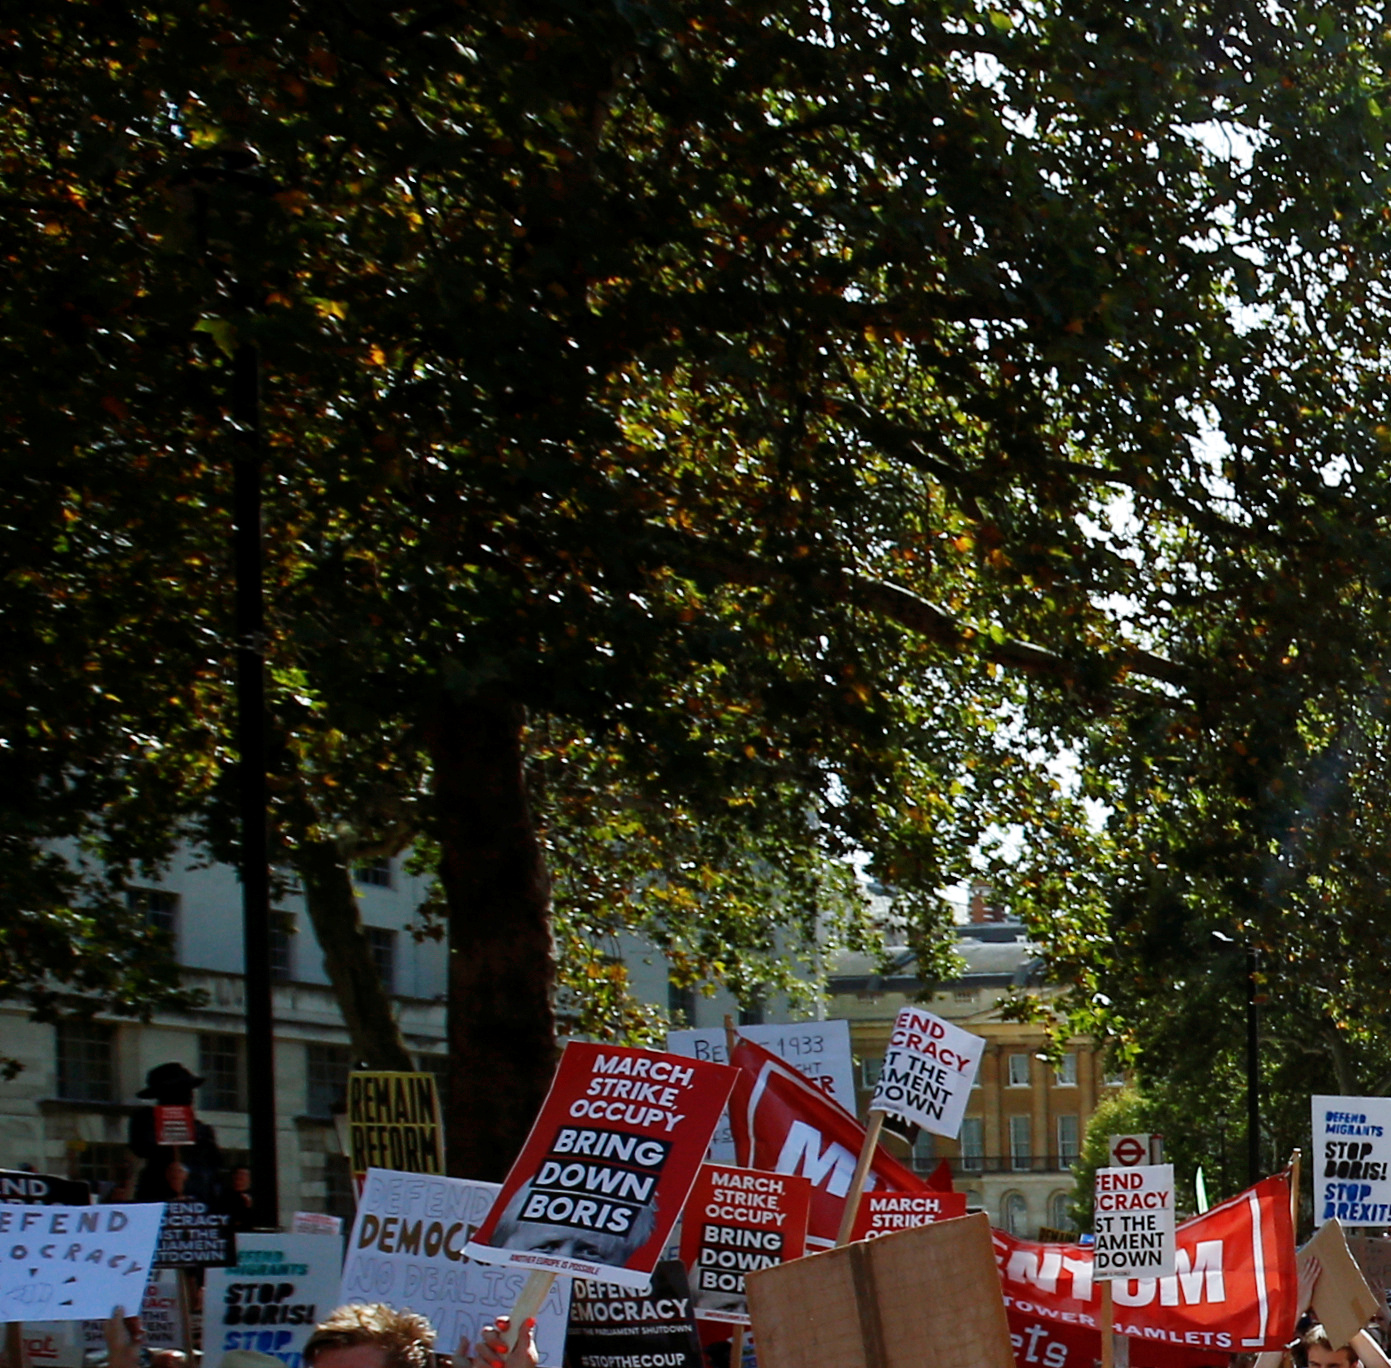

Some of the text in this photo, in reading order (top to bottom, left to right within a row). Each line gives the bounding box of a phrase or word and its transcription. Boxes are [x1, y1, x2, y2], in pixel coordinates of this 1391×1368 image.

[778, 1036, 824, 1057] 1933
[592, 1054, 694, 1089] MARCH,
[908, 1055, 947, 1086] THE
[351, 1077, 433, 1125] REMAIN
[586, 1077, 679, 1109] STRIKE,
[569, 1099, 685, 1131] OCCUPY
[1326, 1111, 1367, 1124] DEFEND
[1325, 1124, 1383, 1137] MIGRANTS
[351, 1126, 441, 1173] REFORM
[552, 1129, 665, 1166] BRING
[1325, 1142, 1372, 1160] STOP
[535, 1161, 654, 1201] DOWN
[1324, 1160, 1388, 1181] BORIS!
[711, 1172, 786, 1196] MARCH,
[1324, 1183, 1372, 1202] STOP
[713, 1189, 780, 1211] STRIKE,
[870, 1198, 942, 1213] MARCH,
[523, 1195, 632, 1232] BORIS
[705, 1205, 787, 1227] OCCUPY
[1124, 1215, 1156, 1231] THE
[703, 1225, 782, 1251] BRING
[538, 1256, 601, 1275] EUROPE IS POSSIBLE
[701, 1248, 781, 1271] DOWN
[223, 1283, 294, 1304] STOP
[348, 1258, 522, 1308] NO DEAL IS
[223, 1304, 315, 1325] BORIS!
[1003, 1295, 1096, 1327] TOWER
[641, 1324, 693, 1335] SHUTDOWN
[1112, 1322, 1232, 1347] HAMLETS
[223, 1331, 292, 1351] STOP
[581, 1353, 686, 1368] #STOPTHECOUP
